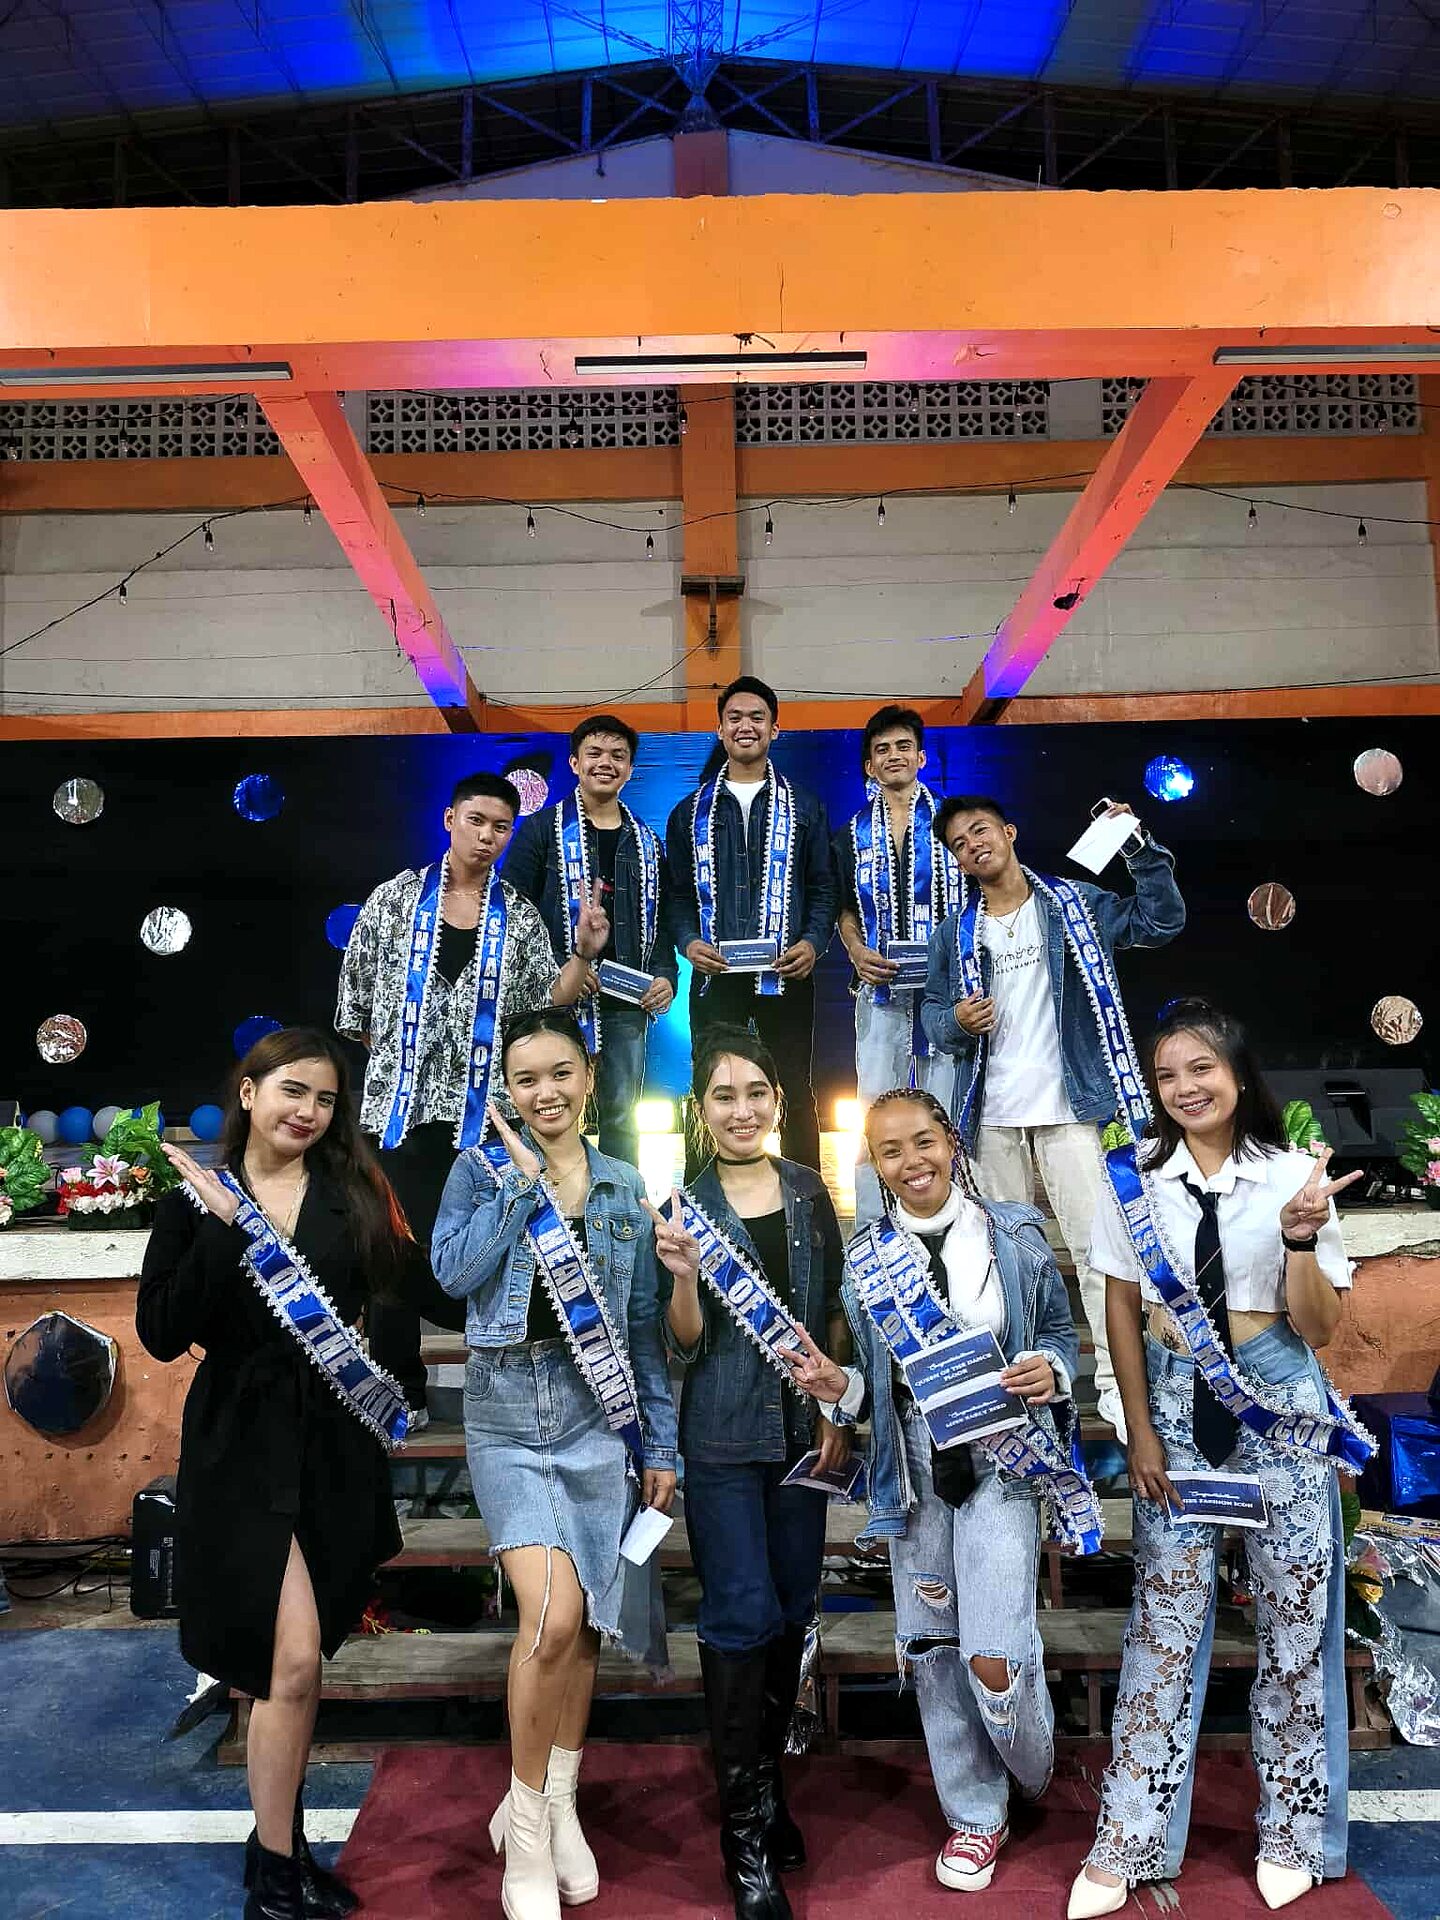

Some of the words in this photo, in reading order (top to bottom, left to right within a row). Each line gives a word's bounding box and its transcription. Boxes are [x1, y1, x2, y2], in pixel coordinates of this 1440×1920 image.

[774, 786, 788, 851] HEAD
[568, 841, 581, 900] THE
[768, 861, 784, 938] TURN
[412, 910, 431, 972] THE
[482, 917, 501, 1000] STAR
[1054, 884, 1106, 987] DANCE
[1105, 1006, 1146, 1120] FLOOR
[398, 1001, 418, 1116] NIGHT
[473, 1046, 488, 1088] OF
[235, 1202, 275, 1258] ACE
[268, 1265, 308, 1306] OF
[306, 1315, 358, 1375] THE
[849, 1230, 895, 1307] UEEN
[536, 1226, 588, 1303] HEAD
[576, 1322, 636, 1432] TURNER
[728, 1277, 766, 1316] OF
[761, 1315, 806, 1362] TH
[1124, 1195, 1163, 1269] MISS
[1168, 1291, 1254, 1416] FASHION
[1264, 1415, 1336, 1454] ICON
[980, 1430, 1041, 1478] NCE
[1055, 1474, 1097, 1534] OOR
